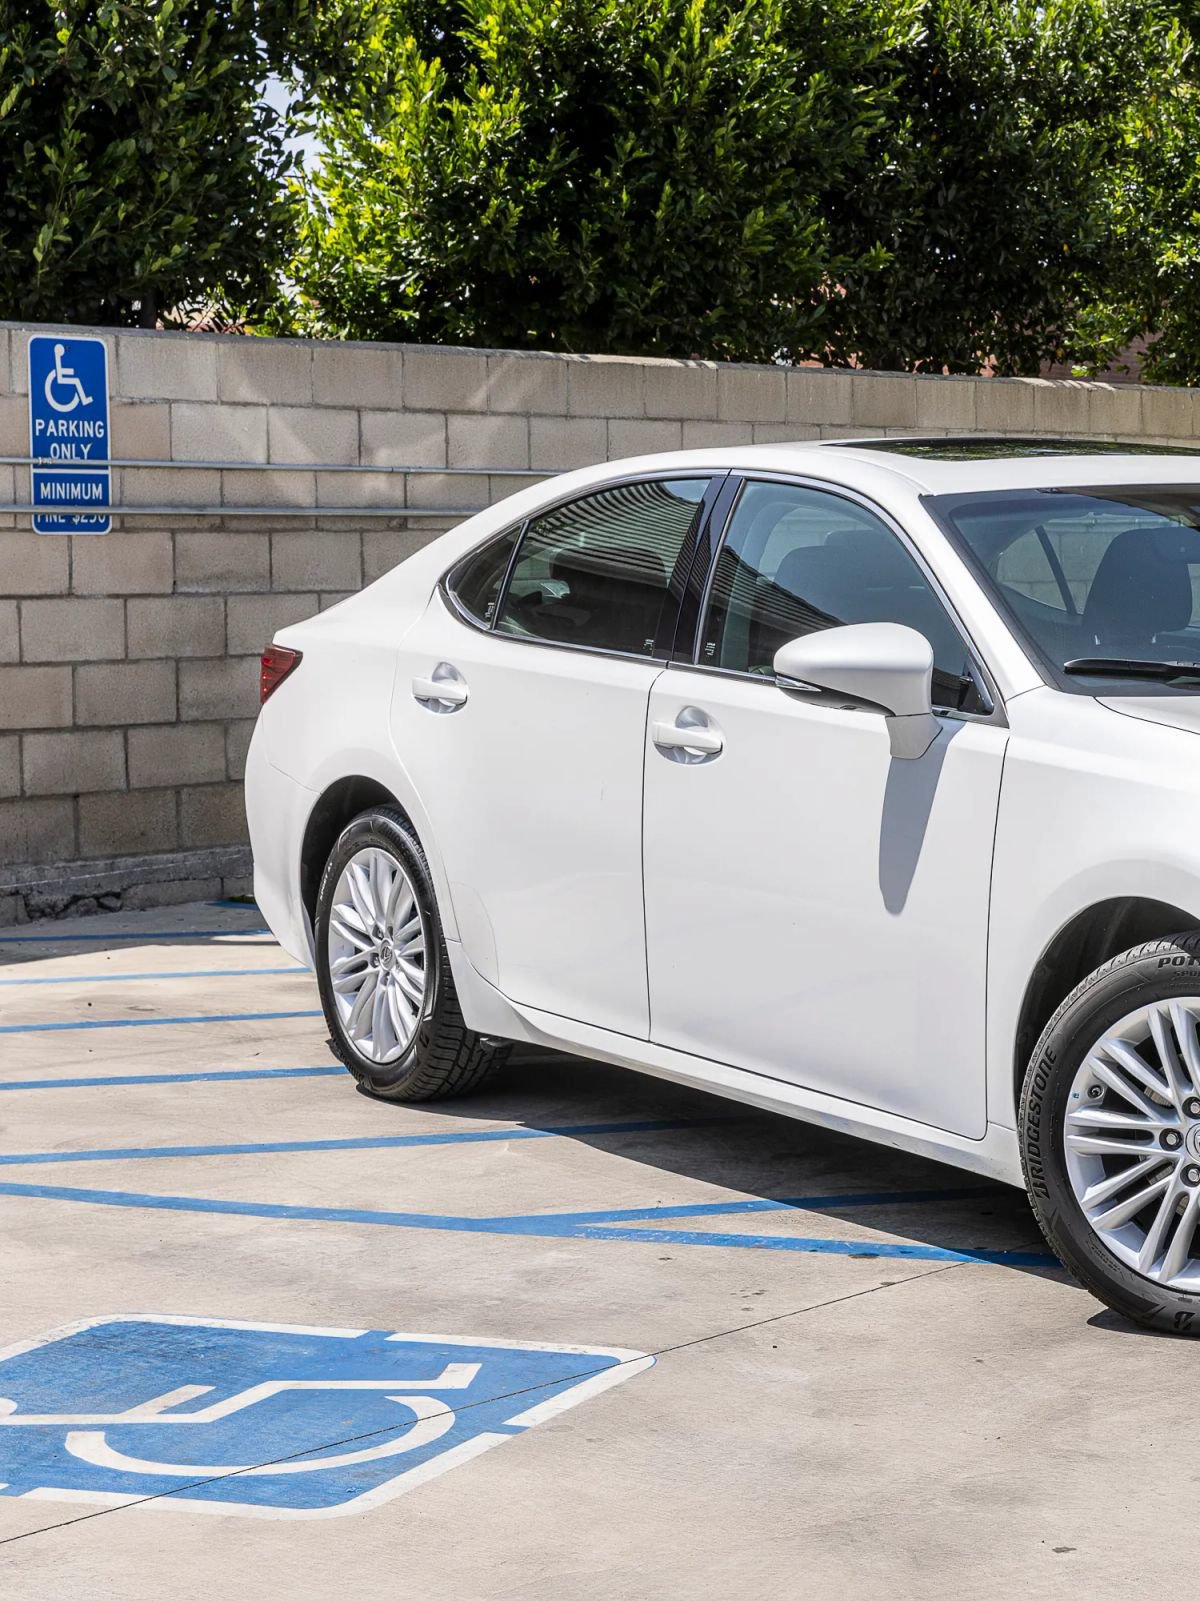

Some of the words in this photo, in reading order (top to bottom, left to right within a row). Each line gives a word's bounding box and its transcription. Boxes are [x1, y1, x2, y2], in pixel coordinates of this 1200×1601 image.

[35, 419, 105, 438] PARKING
[50, 443, 92, 460] ONLY
[40, 482, 103, 500] MINIMUM
[1026, 1045, 1057, 1200] BRIDGESTONE
